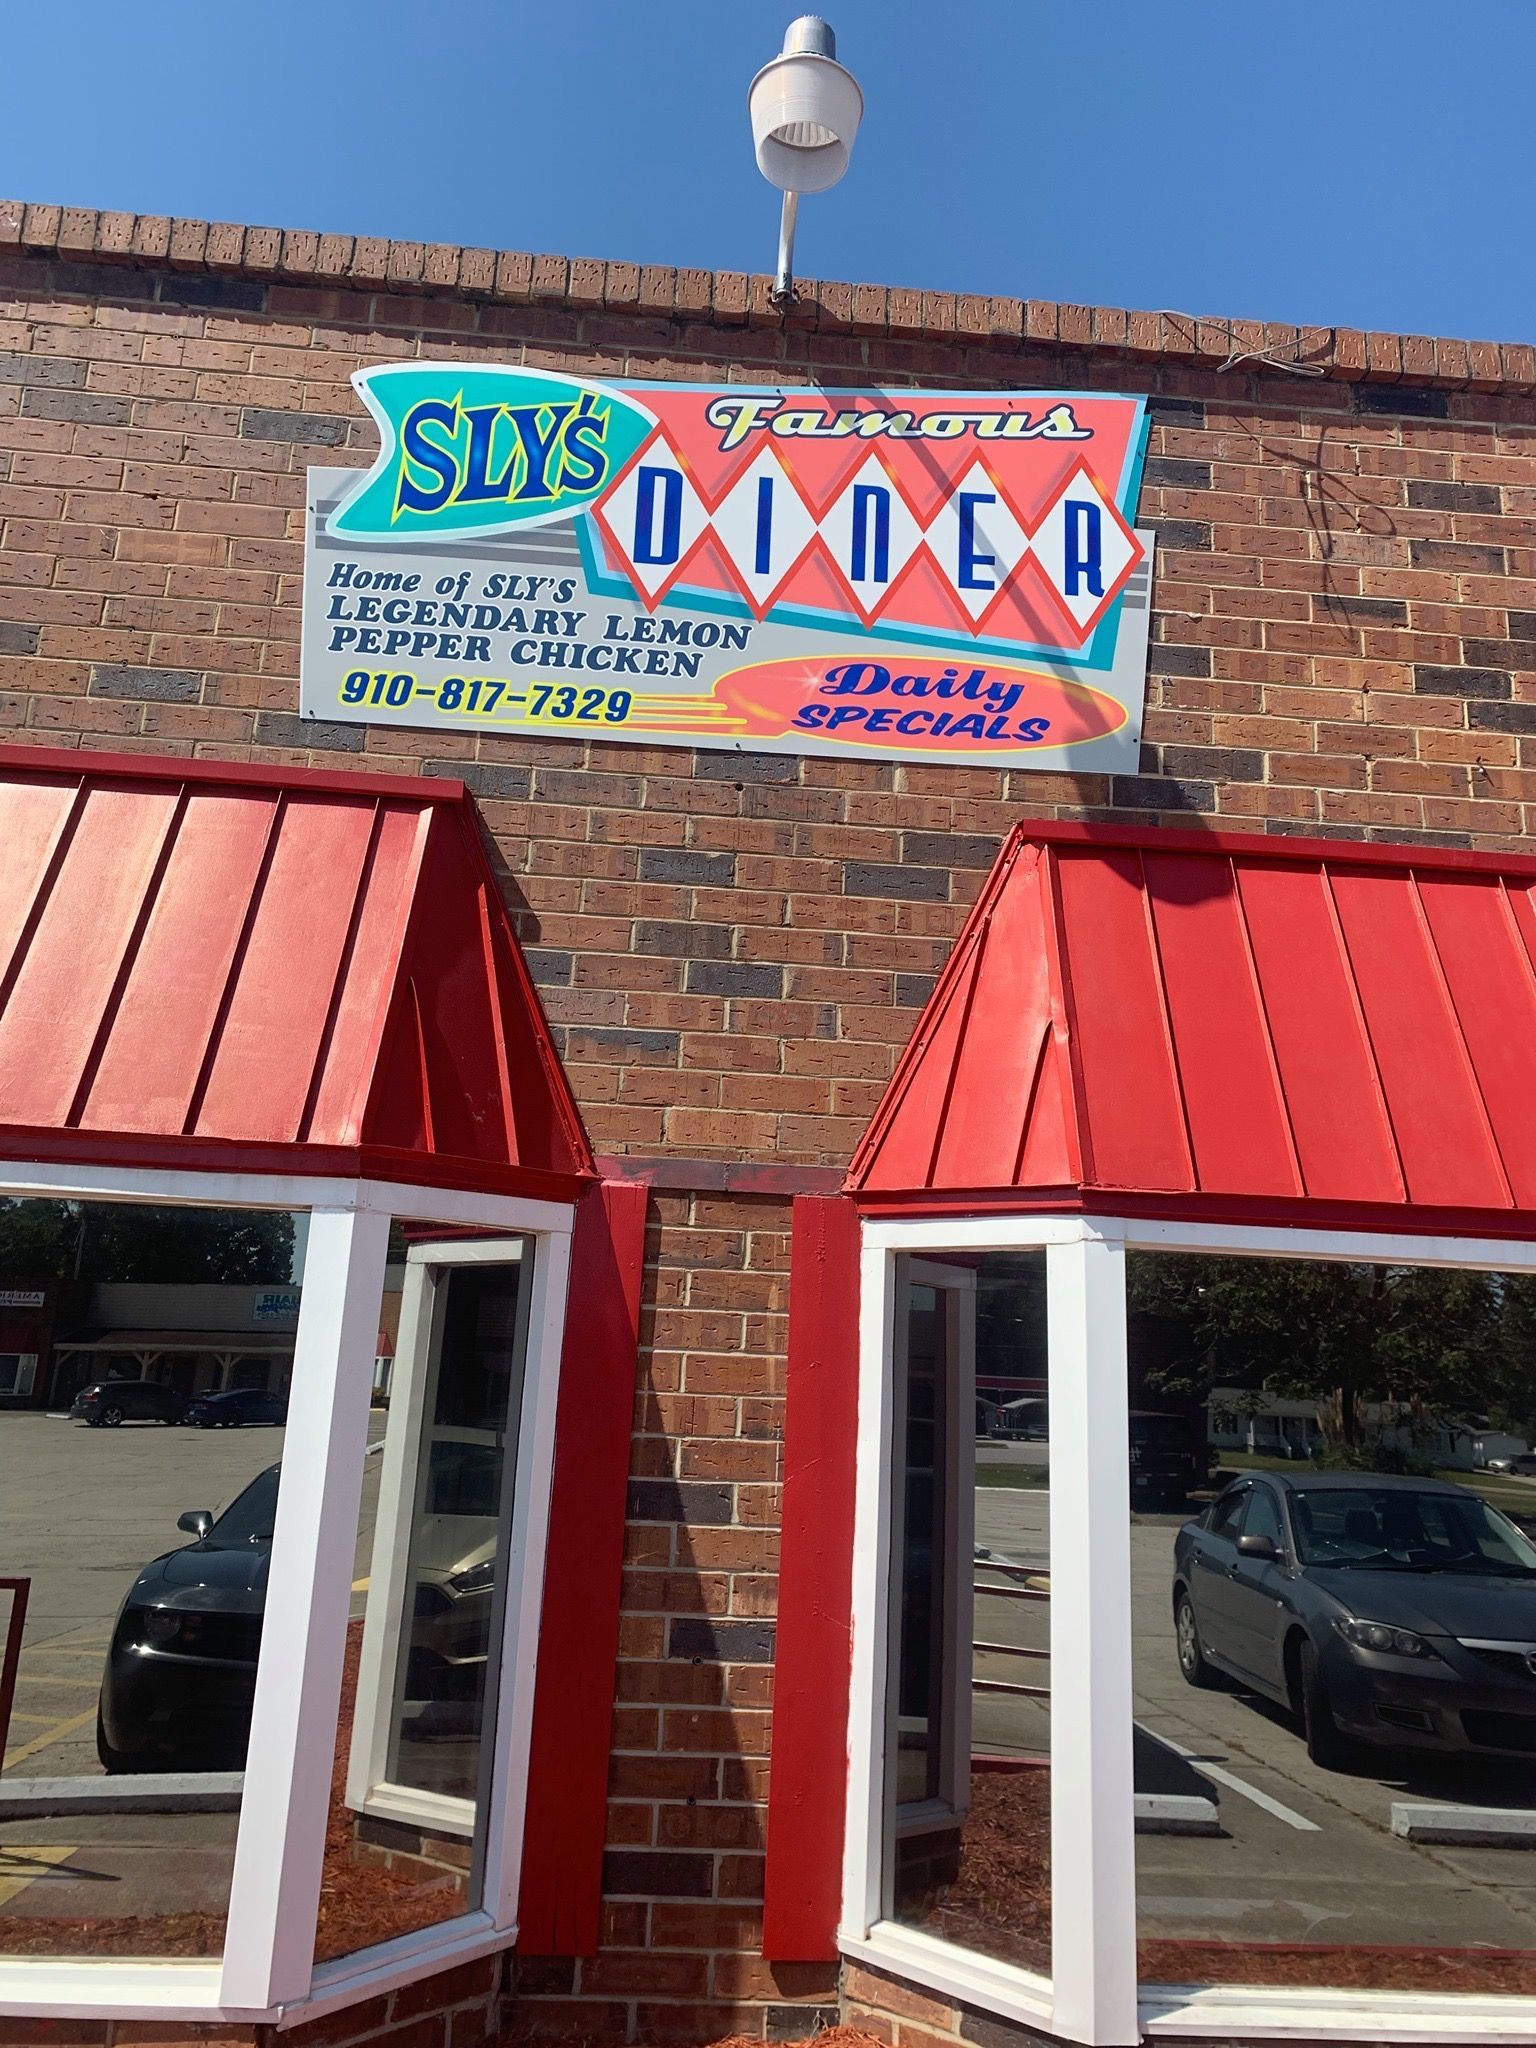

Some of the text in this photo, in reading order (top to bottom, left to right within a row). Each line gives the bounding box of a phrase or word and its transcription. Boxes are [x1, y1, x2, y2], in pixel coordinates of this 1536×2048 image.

[706, 396, 1094, 451] Famous
[632, 465, 1105, 598] DINER
[326, 562, 578, 604] Home of SLY'S
[326, 594, 753, 651] LEGENDARY LEMON
[327, 626, 704, 679] PEPPER CHICKEN
[340, 670, 633, 723] 910-817-7329
[817, 662, 1025, 713] Daily
[790, 703, 1051, 743] SPECIALS
